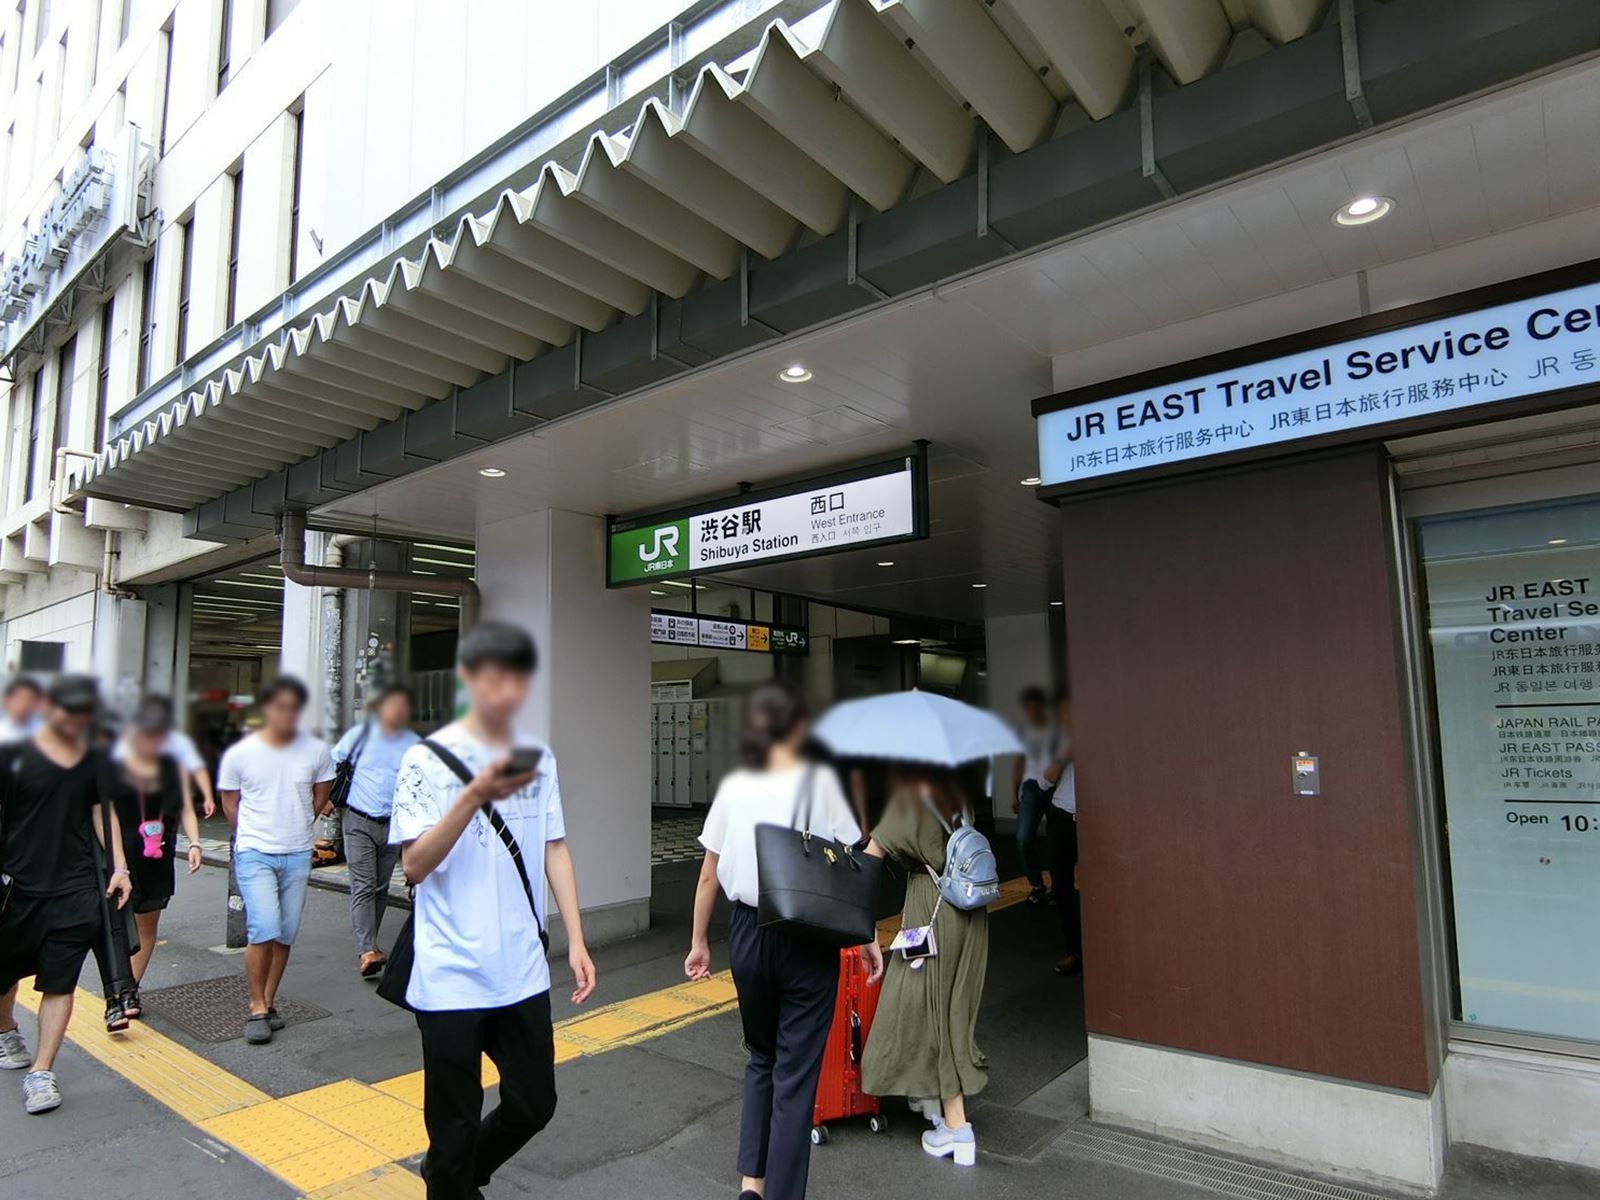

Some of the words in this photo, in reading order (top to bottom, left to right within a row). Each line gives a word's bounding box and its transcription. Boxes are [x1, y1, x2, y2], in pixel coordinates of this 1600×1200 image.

[1067, 412, 1105, 442] JR
[1117, 387, 1206, 431] EAST
[1217, 359, 1332, 408] Travel
[1347, 325, 1511, 381] Service
[1526, 304, 1600, 341] Ce
[1070, 420, 1254, 472] JR东日本旅行服务中心
[1269, 367, 1508, 430] JR東日本旅行服務中心
[1528, 356, 1560, 379] JR
[810, 492, 844, 516] 西口
[701, 509, 761, 543] 渋谷駅
[811, 517, 836, 530] West
[839, 509, 885, 525] Entrance
[639, 525, 679, 562] JR
[811, 531, 836, 544] 西入口
[700, 543, 749, 562] Shibuya
[752, 534, 799, 553] Station
[1486, 585, 1515, 602] JR
[1524, 578, 1590, 599] EAST
[1487, 602, 1559, 622] Travel
[786, 632, 799, 643] JR
[1490, 626, 1568, 643] Center
[1494, 682, 1510, 693] JR
[1497, 717, 1543, 729] JAPAN
[1548, 717, 1583, 728] RAIL
[1499, 742, 1517, 753] JR
[1522, 742, 1561, 753] EAST
[1502, 767, 1520, 778] JR
[1524, 767, 1573, 778] Tickets
[1506, 811, 1549, 826] Open
